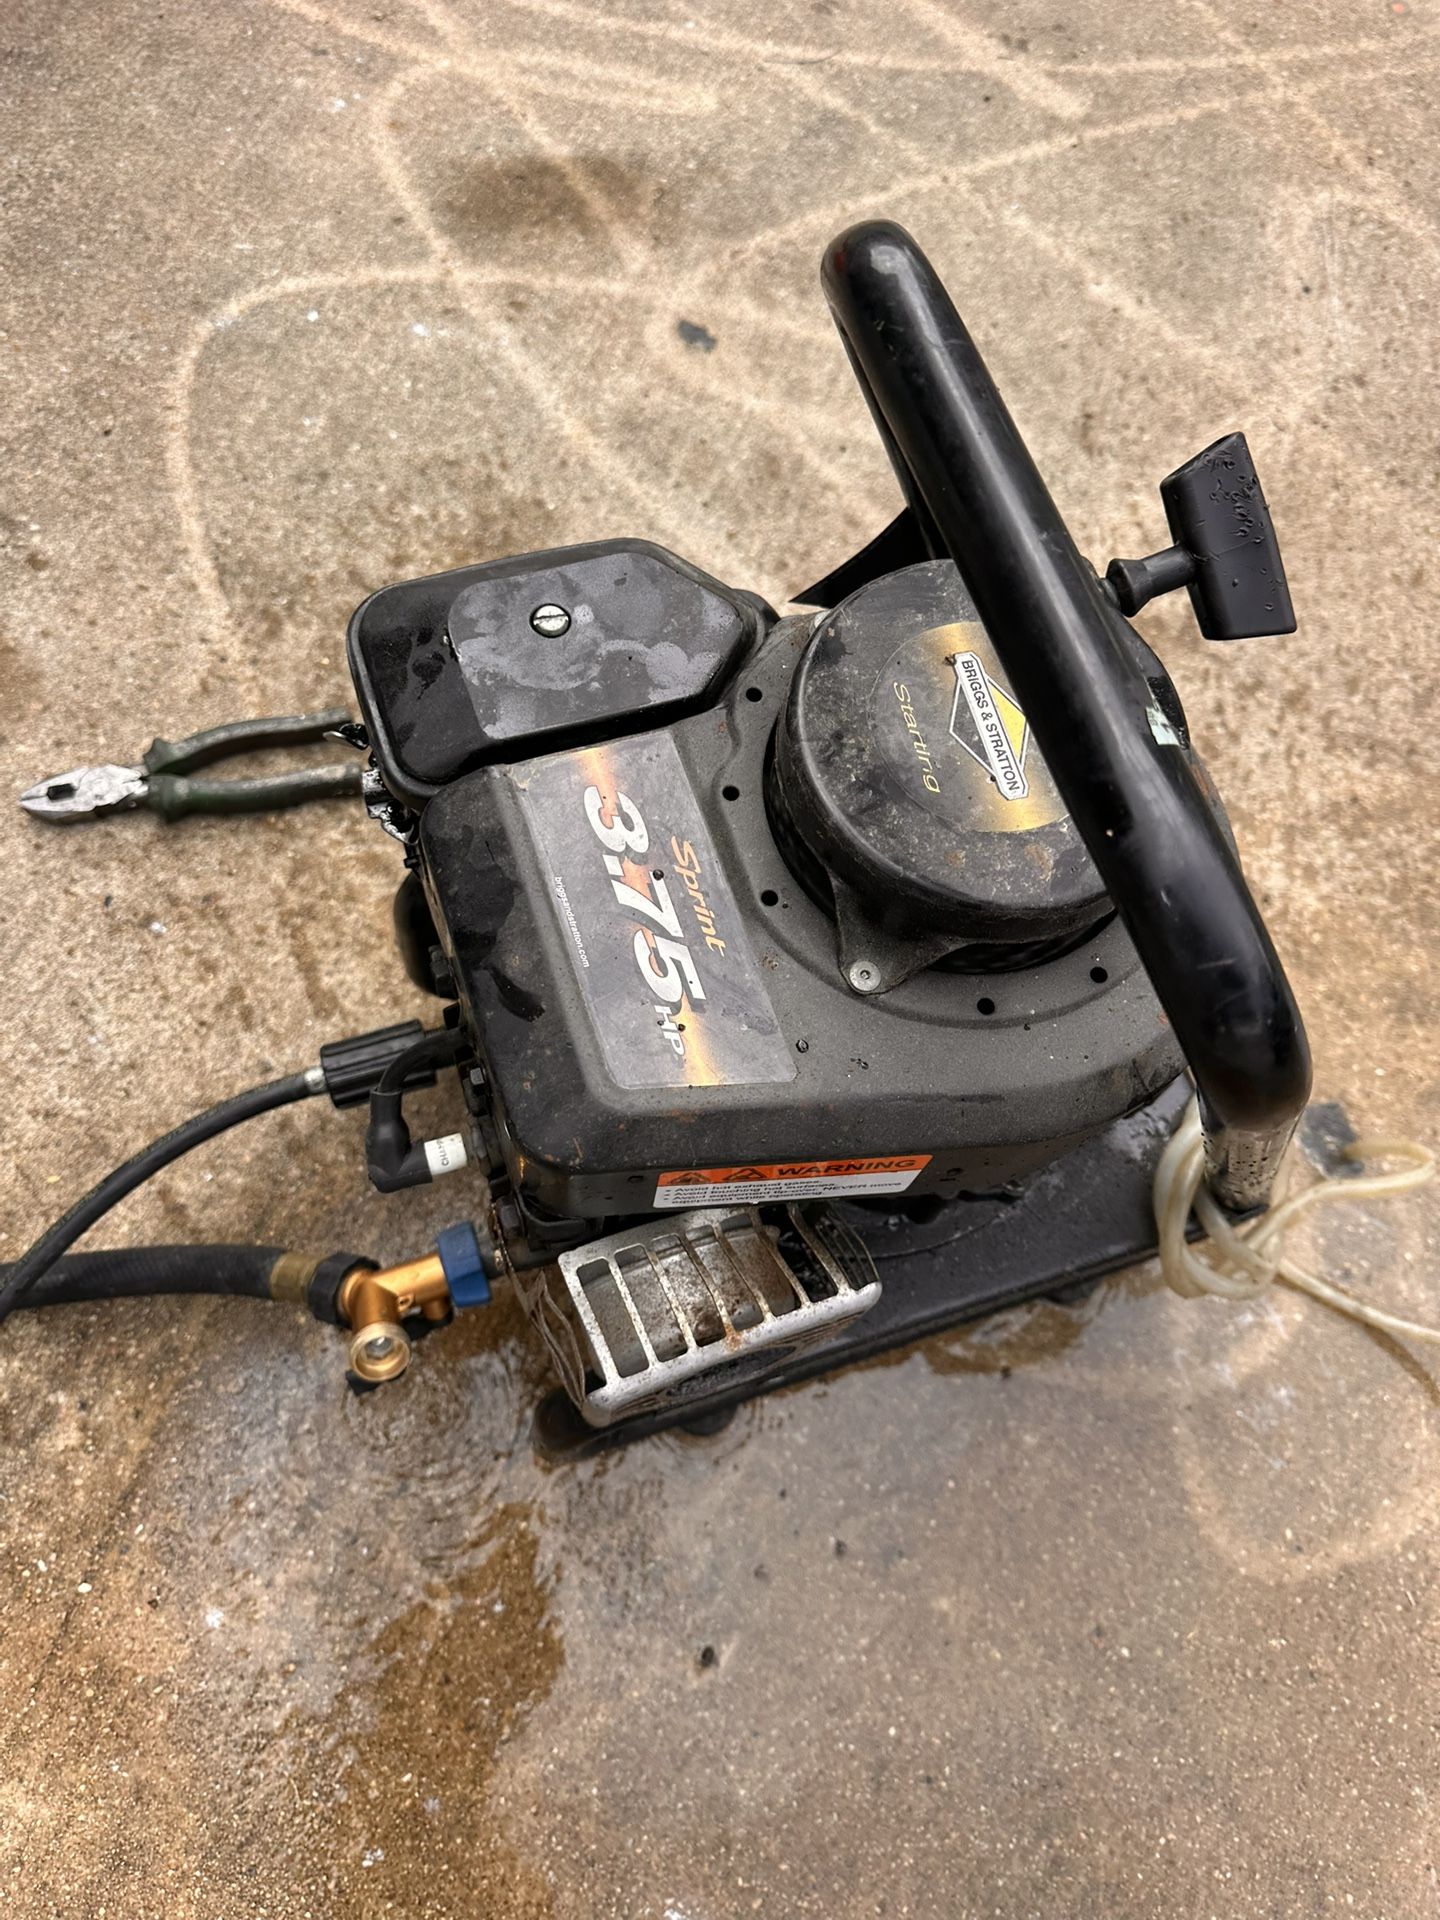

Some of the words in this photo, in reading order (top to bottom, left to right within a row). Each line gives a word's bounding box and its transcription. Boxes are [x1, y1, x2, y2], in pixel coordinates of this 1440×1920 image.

[961, 660, 989, 709] BRIGGS
[981, 711, 993, 721] &
[893, 681, 941, 793] Starting
[985, 724, 1020, 790] STRATTON
[554, 876, 590, 967] briggsandstratton.com
[583, 785, 707, 1003] 3.75
[654, 1004, 686, 1056] HP
[671, 835, 727, 957] Sprint
[777, 1158, 916, 1176] WARNING
